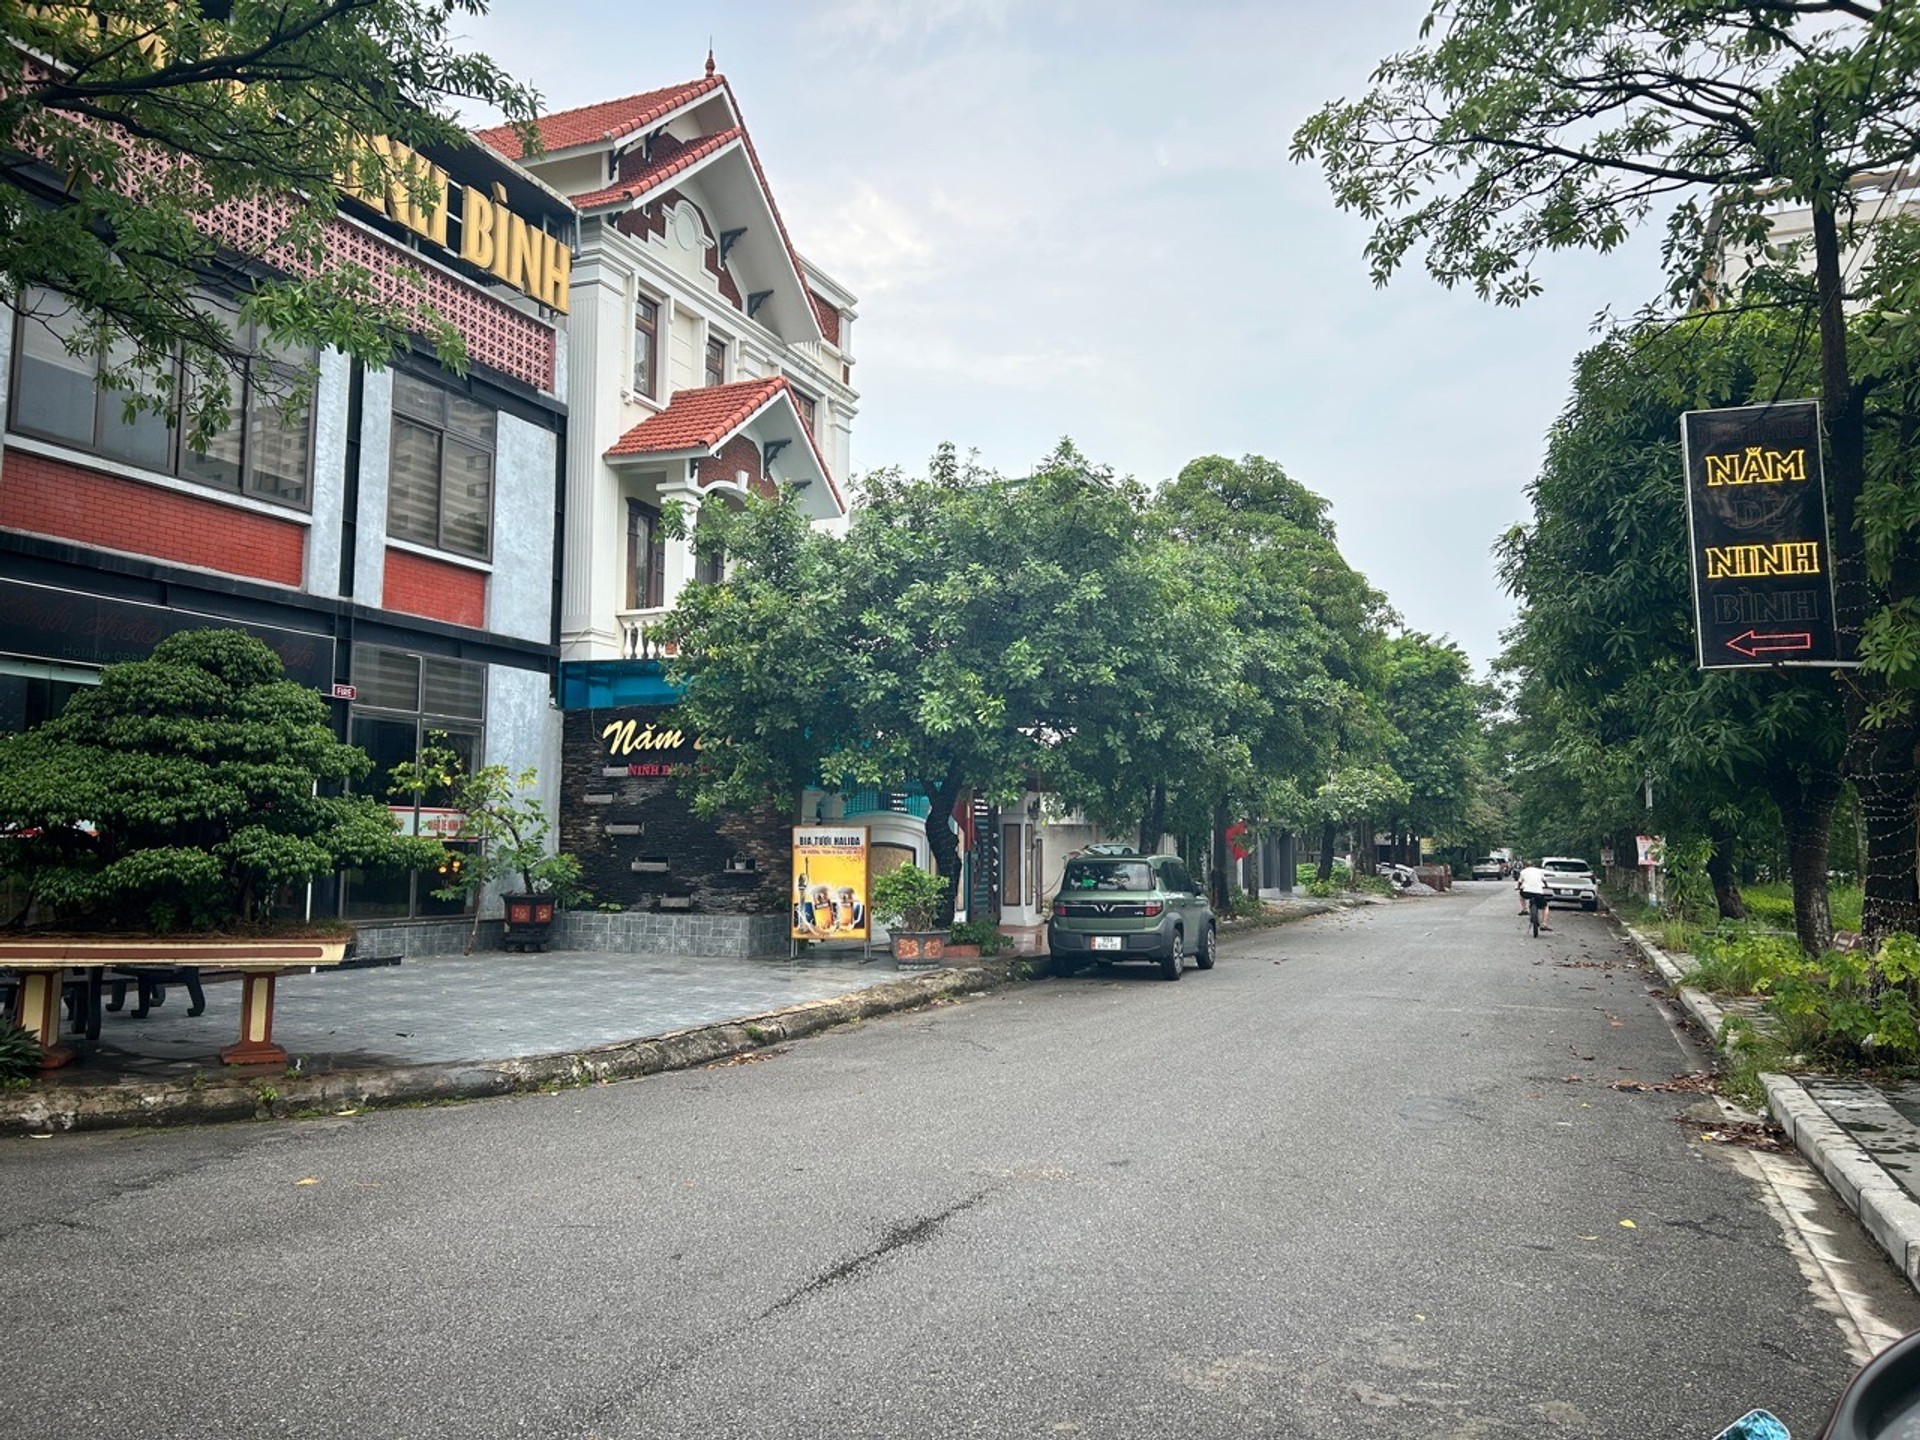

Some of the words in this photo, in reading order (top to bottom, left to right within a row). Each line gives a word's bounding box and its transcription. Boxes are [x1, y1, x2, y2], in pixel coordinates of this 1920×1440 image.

[460, 181, 572, 316] BÌNH
[1705, 446, 1806, 487] NĂM
[1705, 542, 1820, 579] NINH
[1714, 586, 1819, 625] BÌNH
[602, 718, 686, 757] Năm
[628, 763, 660, 776] NINH
